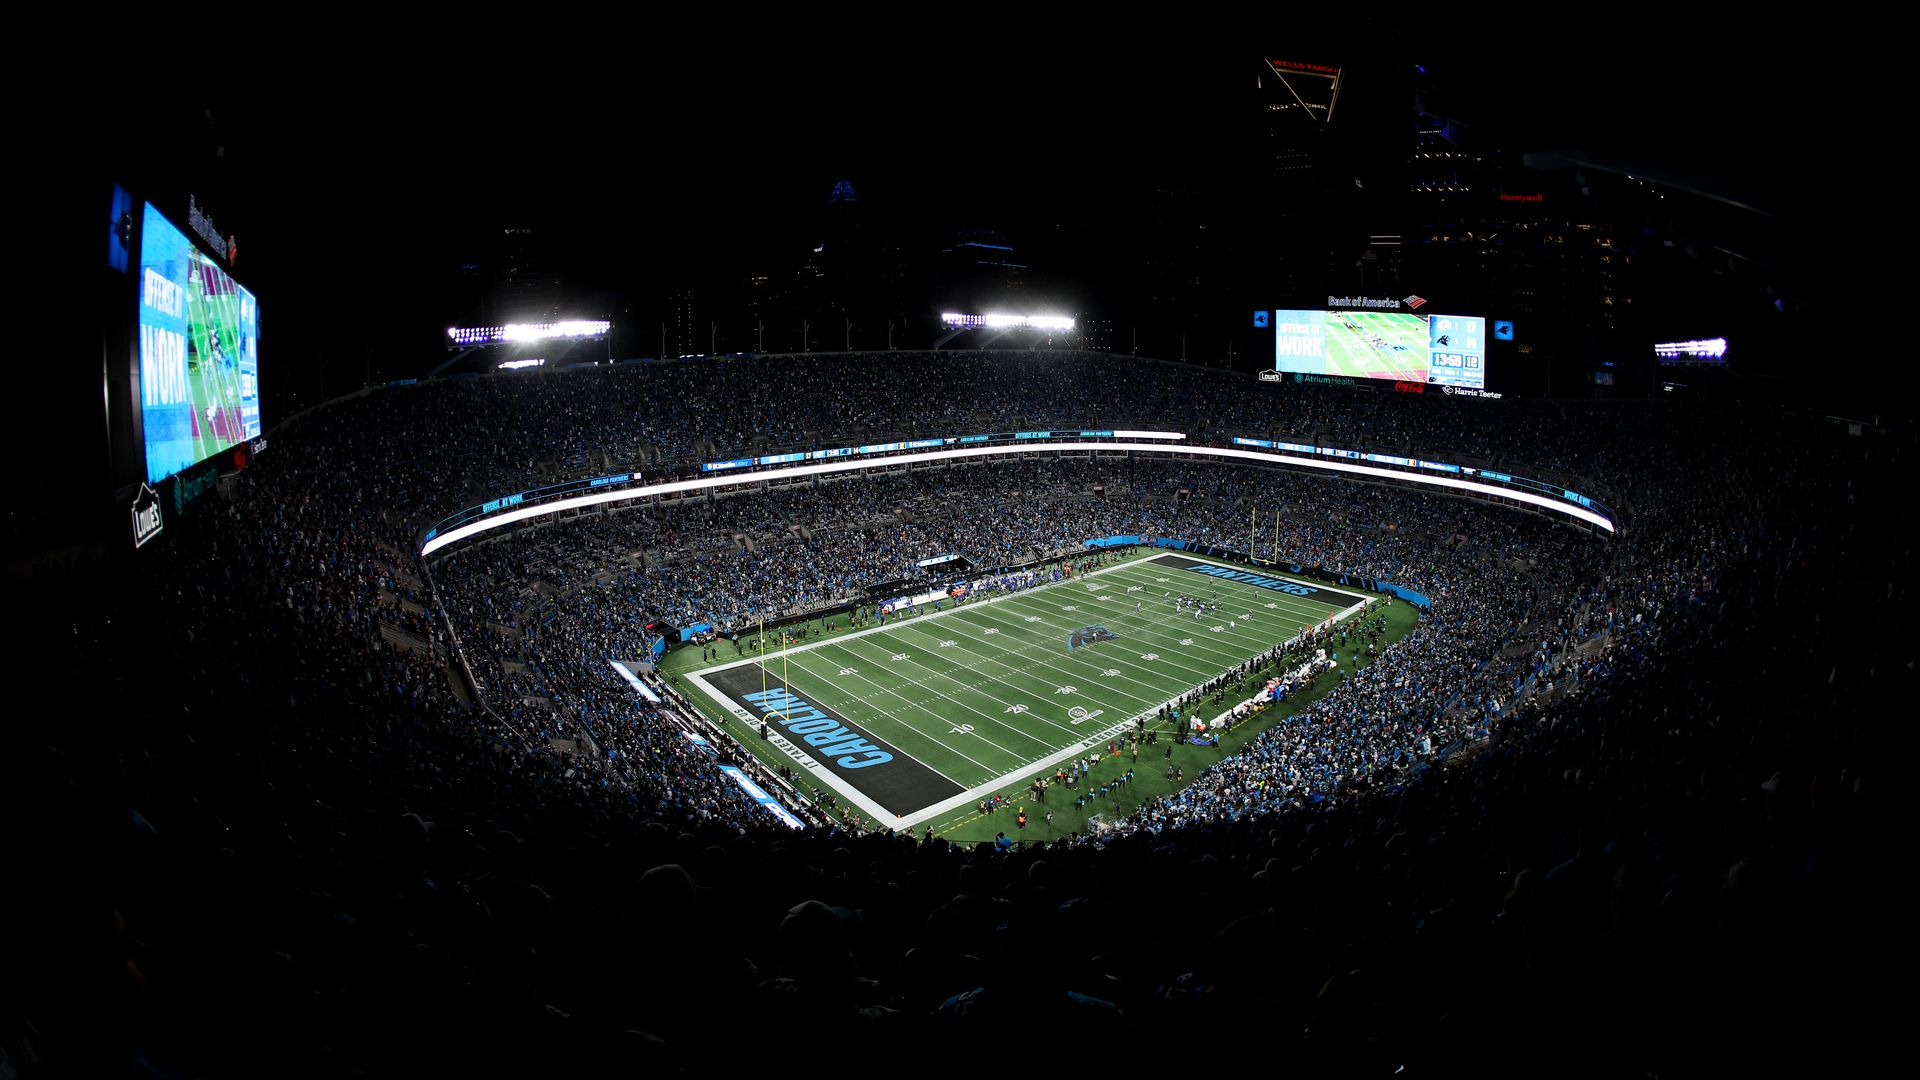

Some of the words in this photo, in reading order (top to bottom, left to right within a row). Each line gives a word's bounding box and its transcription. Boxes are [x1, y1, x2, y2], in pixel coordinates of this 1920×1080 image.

[1273, 59, 1304, 69] WELLS
[1306, 64, 1337, 73] FARGO
[1501, 194, 1542, 202] Honeywell
[144, 267, 175, 316] OFFENSE
[1328, 296, 1351, 307] Bank
[1352, 297, 1361, 307] of
[1361, 297, 1400, 308] America
[1278, 336, 1322, 356] WORK
[141, 323, 187, 406] WORK
[1305, 374, 1330, 384] Atrium
[1331, 376, 1355, 386] Health
[1454, 387, 1478, 396] Harris
[1478, 390, 1502, 399] Teeter
[483, 499, 500, 513] OFFENSE
[509, 494, 523, 505] WORK
[1185, 564, 1318, 596] PANTHERS
[734, 708, 748, 718] US
[1007, 703, 1029, 714] 20
[742, 687, 894, 769] CAROLINA
[744, 717, 760, 726] OF
[953, 723, 975, 735] 10
[1081, 723, 1133, 748] AMERICA
[774, 738, 806, 760] TAKES
[803, 760, 819, 769] IT
